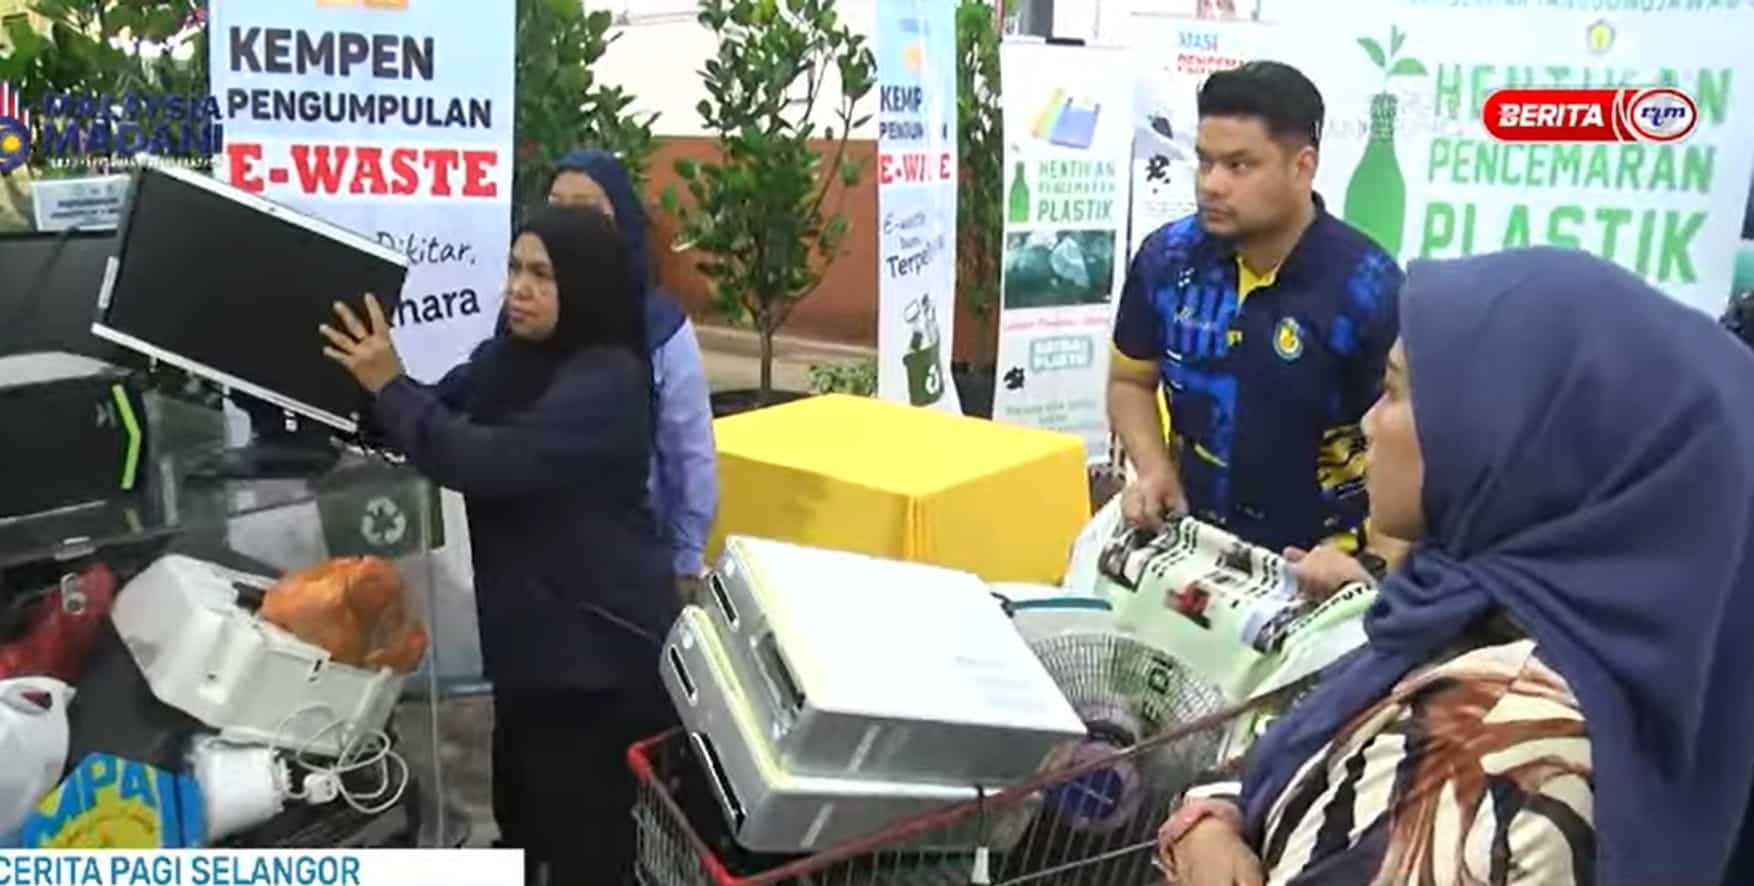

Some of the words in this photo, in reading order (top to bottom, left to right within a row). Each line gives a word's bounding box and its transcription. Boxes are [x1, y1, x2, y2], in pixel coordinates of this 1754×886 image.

[229, 26, 435, 81] KEMPEN
[227, 88, 492, 128] PENGUMPULAN
[227, 143, 497, 197] E-WASTE
[1427, 138, 1717, 193] PENCEMARAN
[1038, 199, 1113, 222] PLASTIK
